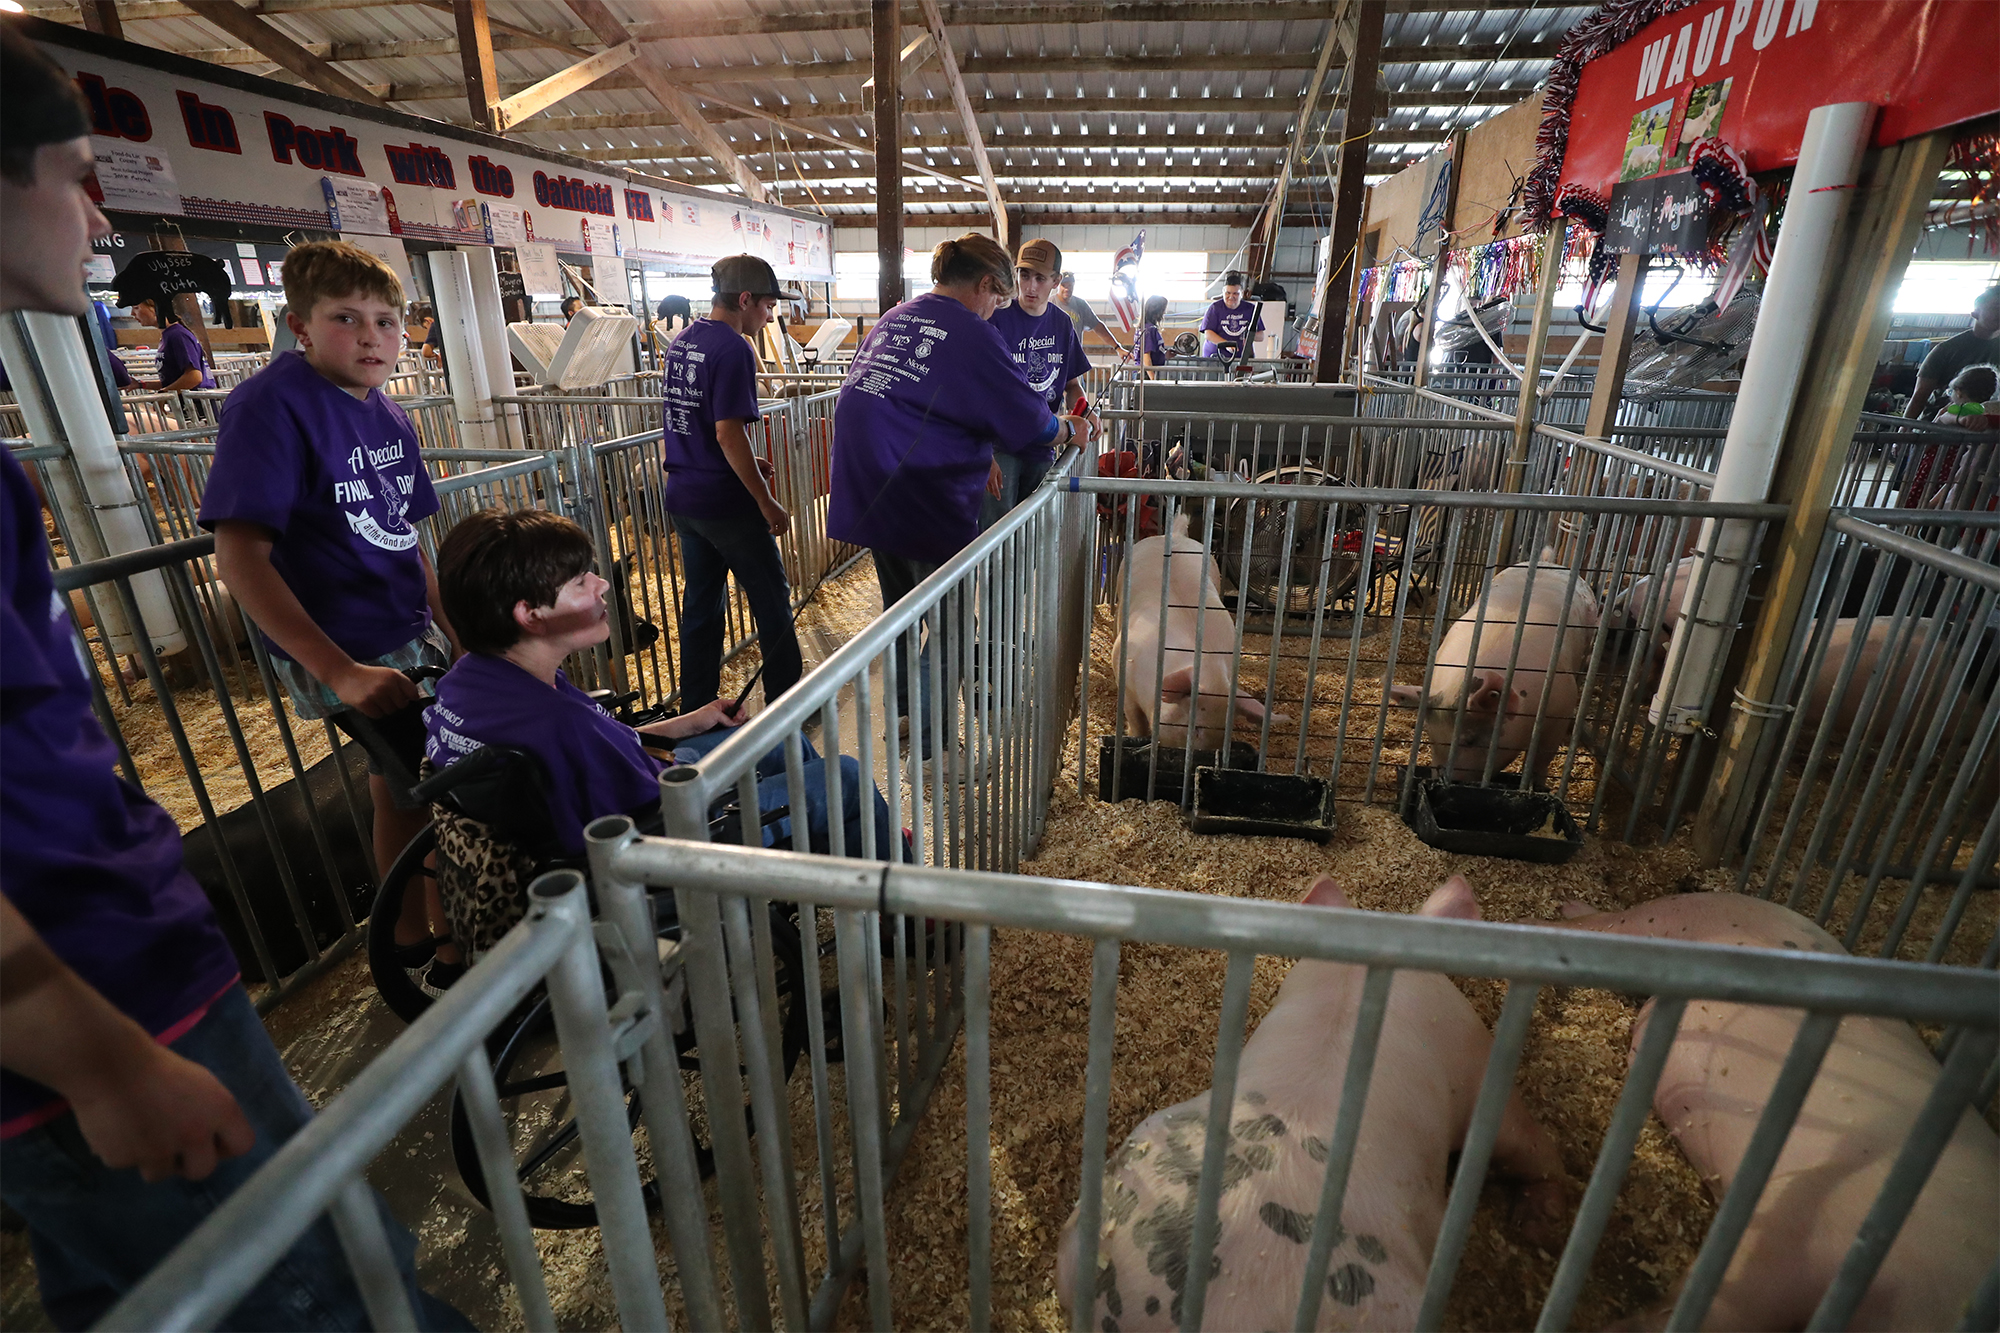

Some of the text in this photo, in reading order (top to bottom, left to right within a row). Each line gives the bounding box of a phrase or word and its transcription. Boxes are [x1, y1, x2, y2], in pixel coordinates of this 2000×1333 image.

[175, 89, 242, 155] in
[263, 110, 366, 177] Pork
[383, 142, 458, 190] with
[468, 155, 515, 198] the
[533, 170, 616, 217] Oakfield
[624, 188, 655, 222] FFA
[93, 233, 126, 248] ING
[147, 257, 193, 277] Ulysses
[160, 279, 199, 295] Ruth
[895, 313, 937, 325] 2025 Sponsors
[1018, 335, 1056, 351] A Special
[905, 357, 931, 375] Nicolet
[1011, 352, 1027, 364] NAL
[892, 366, 921, 382] COMMITTEE
[347, 446, 365, 475] A
[334, 479, 375, 504] FINAL
[363, 523, 372, 534] at
[368, 527, 382, 541] the
[379, 534, 399, 548] Fond
[447, 731, 485, 750] TRACTO
